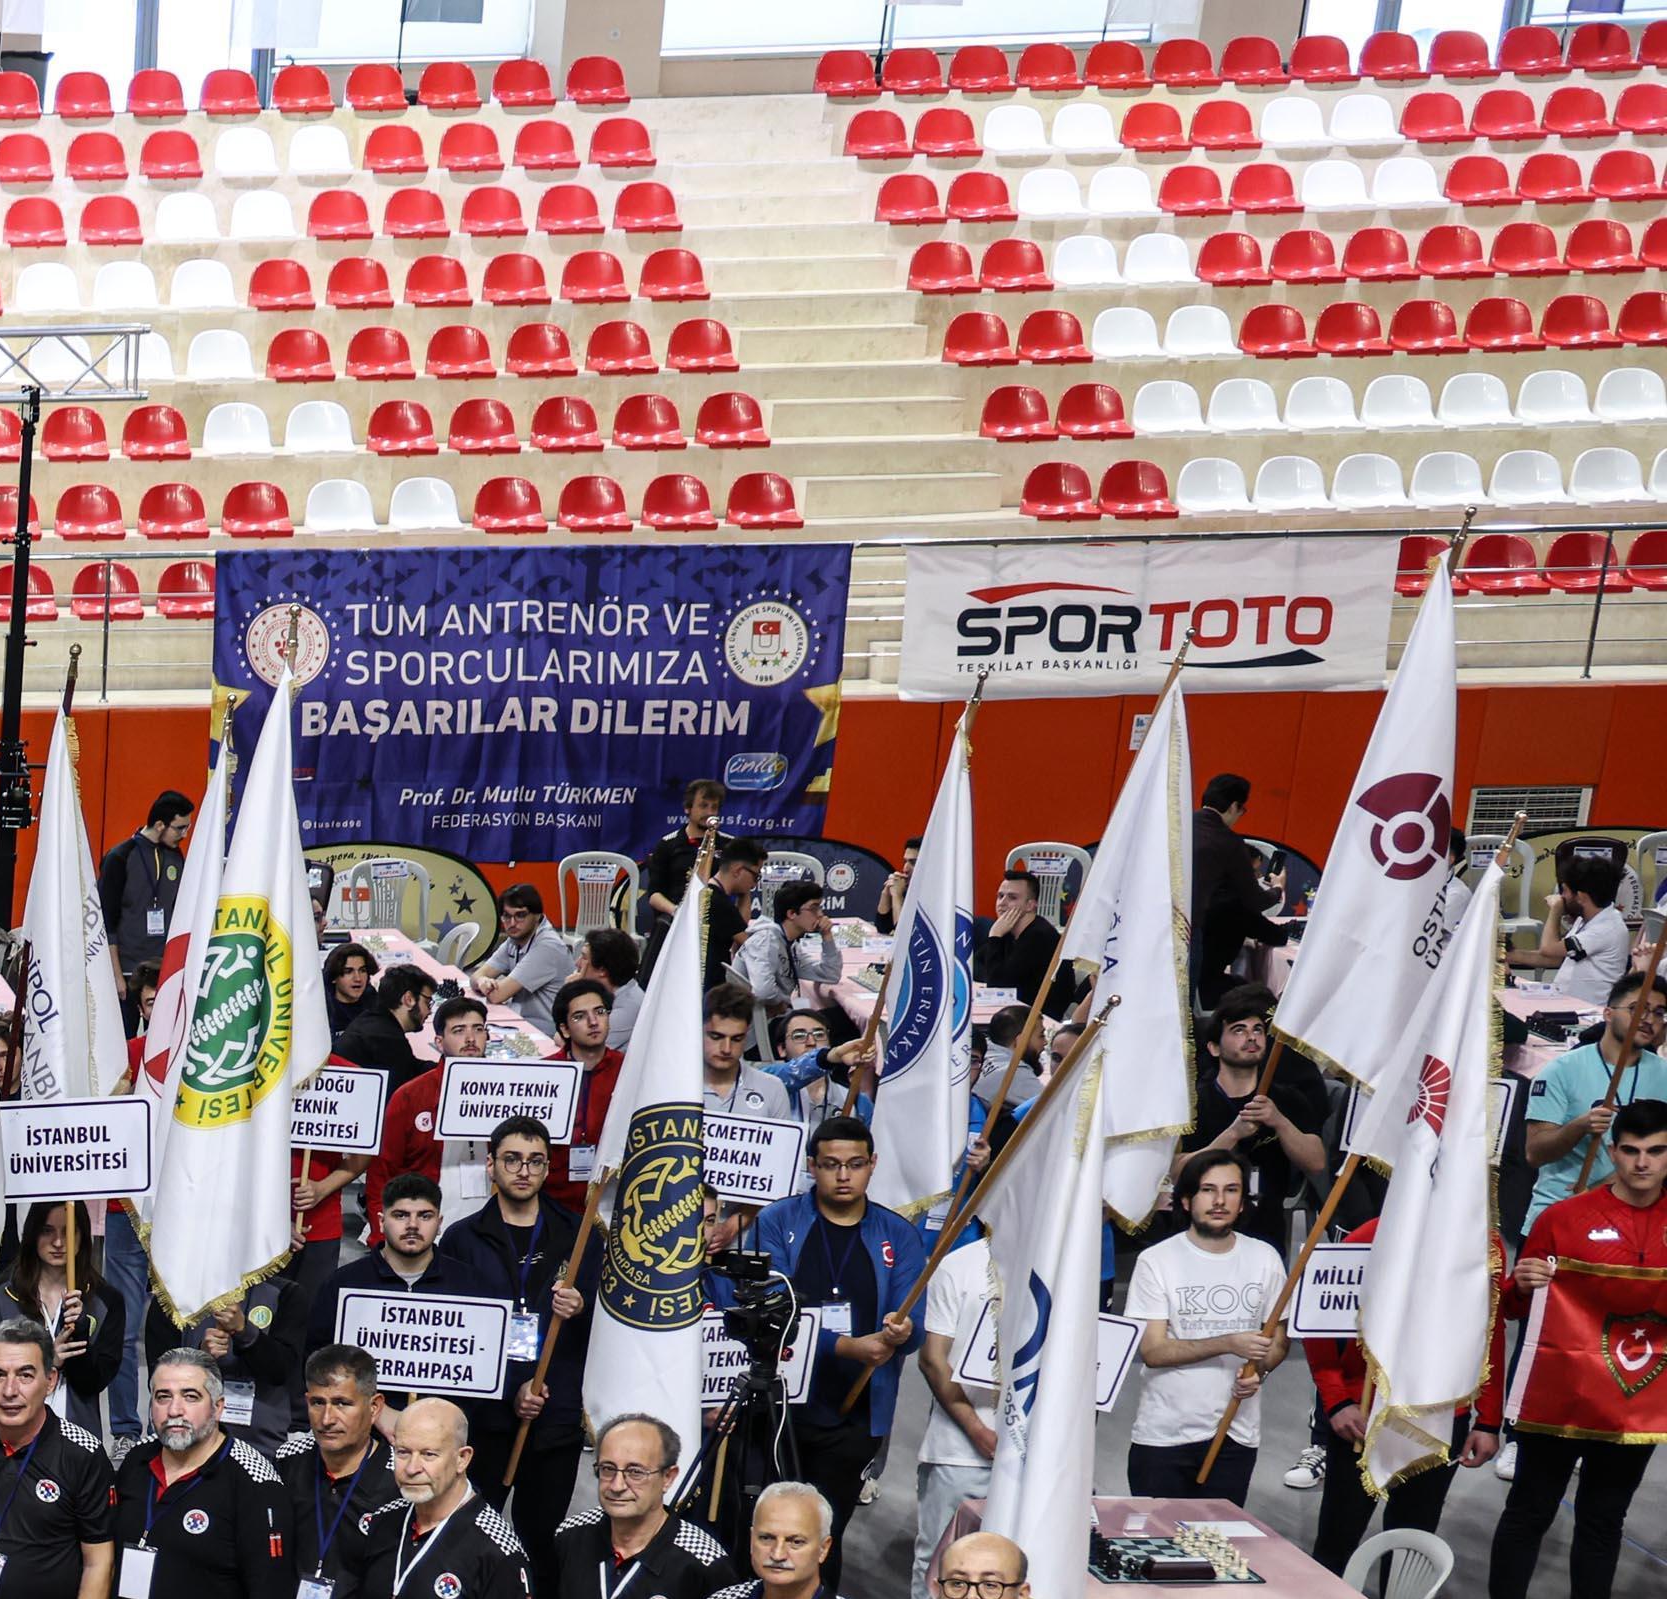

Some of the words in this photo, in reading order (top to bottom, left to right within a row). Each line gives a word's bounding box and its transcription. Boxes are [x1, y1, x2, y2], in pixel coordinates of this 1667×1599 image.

[345, 595, 426, 637] TÜM
[438, 595, 649, 637] ANTRENÖR
[662, 602, 711, 636] VE
[345, 647, 710, 685] SPORCULARIMIZA
[1041, 657, 1138, 671] BAŞKANLIĞI
[301, 697, 559, 743] BAŞARILAR
[399, 788, 445, 806] Prof.
[452, 788, 476, 805] Dr.
[482, 786, 536, 805] Mutlu
[543, 785, 638, 804] TÜRKMEN
[431, 812, 530, 829] FEDERASYON
[535, 812, 602, 830] BAŞKANI
[315, 1075, 355, 1093] DOĞU
[460, 1081, 505, 1097] KONYA
[509, 1080, 560, 1098] TEKNİK
[293, 1097, 339, 1115] EKNİK
[459, 1099, 554, 1120] ÜNİVERSİTESİ
[27, 1125, 111, 1146] İSTANBUL
[10, 1148, 128, 1174] ÜNİVERSİTESİ
[1312, 1265, 1363, 1285] MİLLİ
[1175, 1282, 1264, 1319] KOÇ
[381, 1302, 466, 1328] İSTANBUL
[356, 1327, 475, 1356] ÜNİVERSİTESİ
[376, 1359, 474, 1386] ERRAHPAŞA
